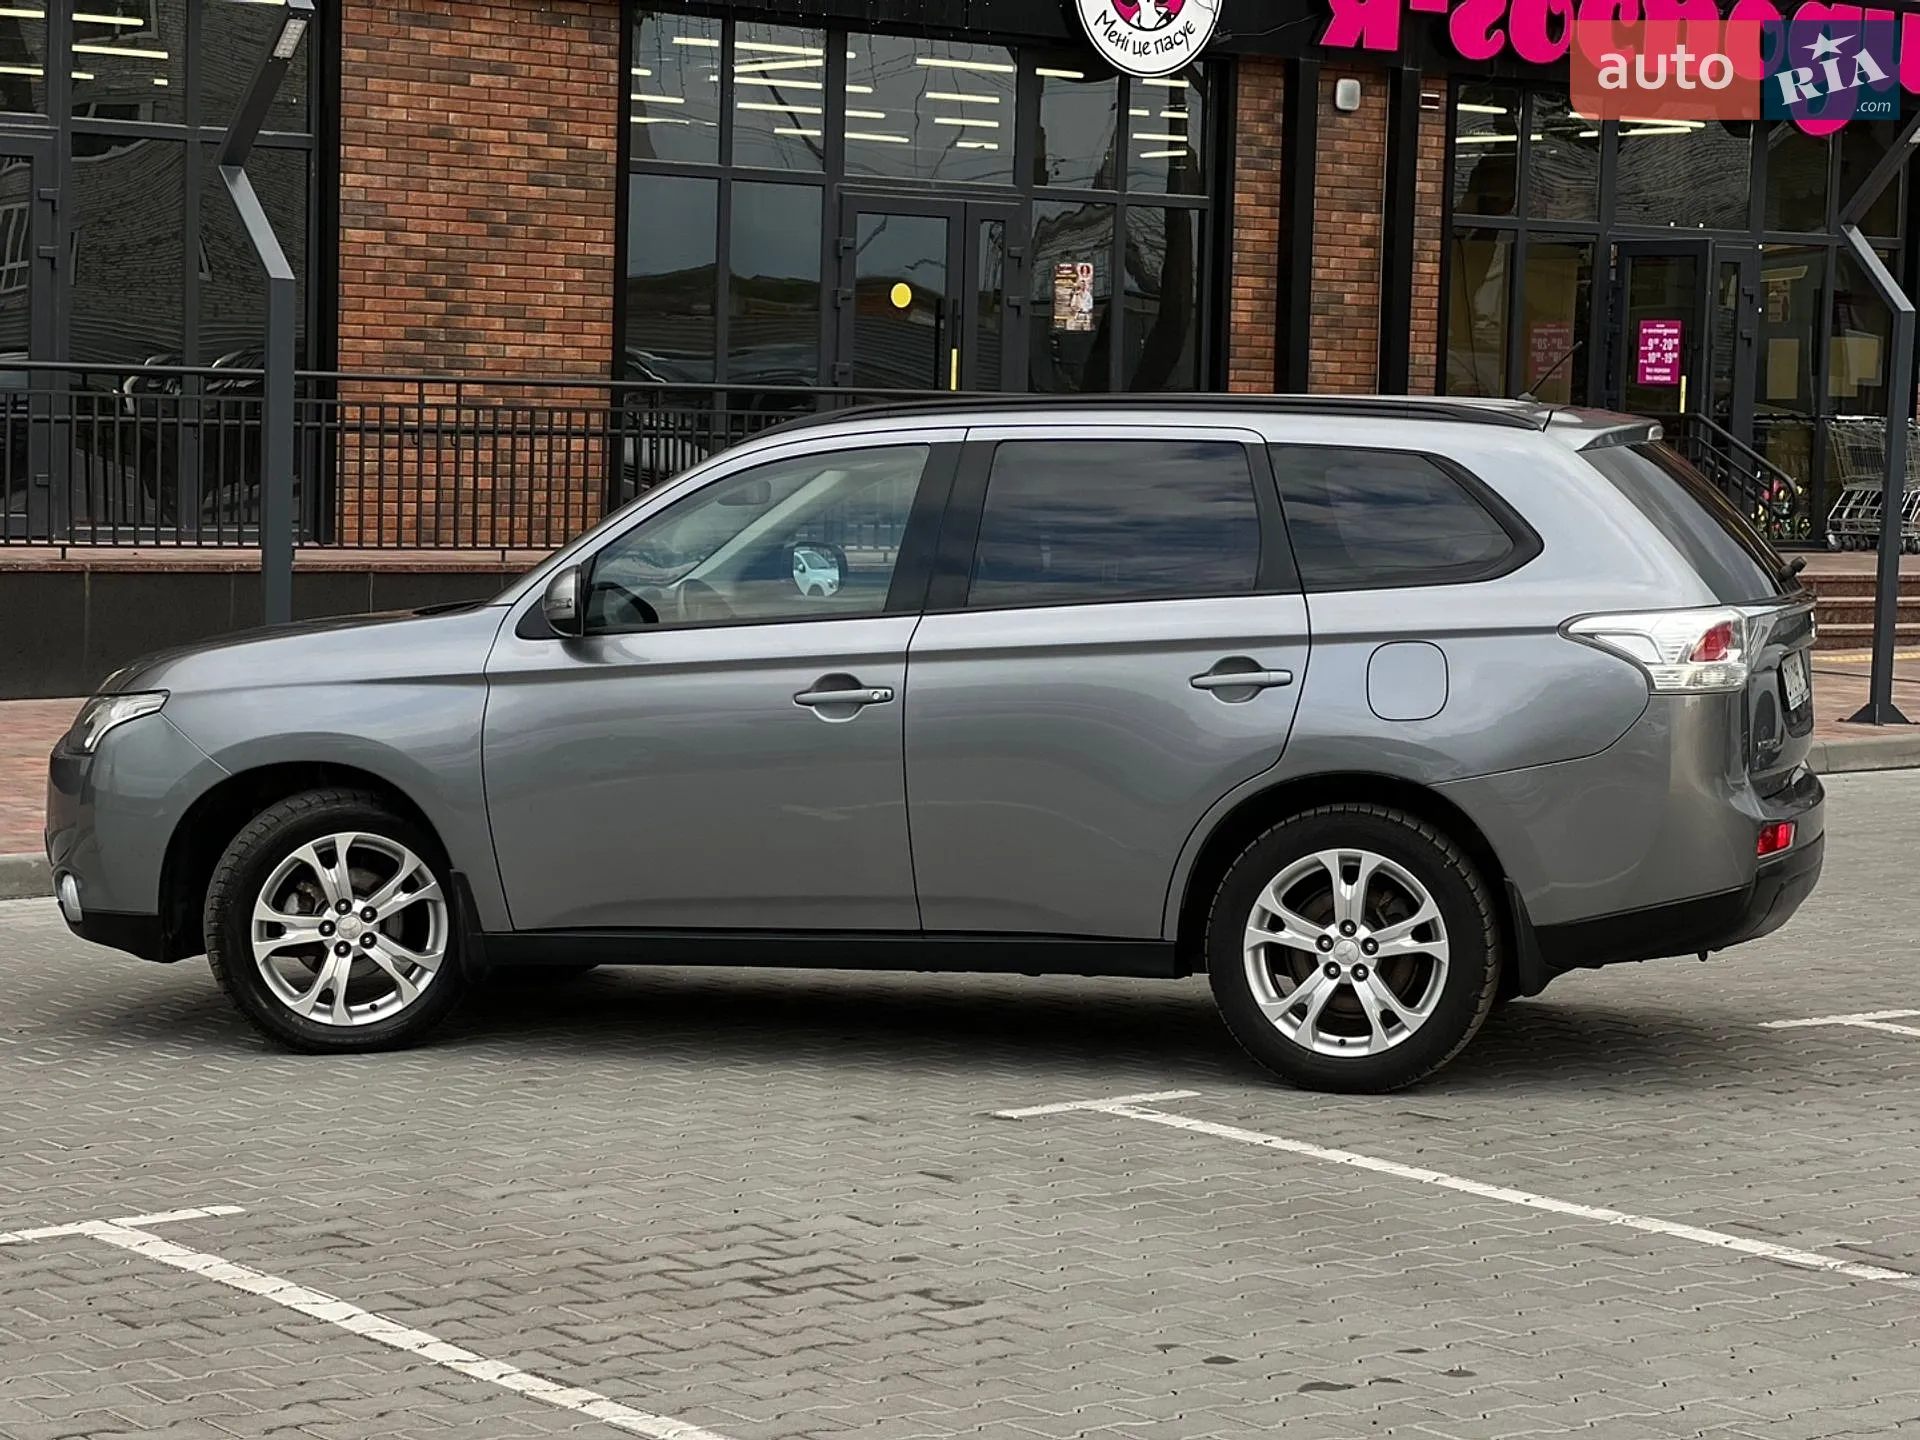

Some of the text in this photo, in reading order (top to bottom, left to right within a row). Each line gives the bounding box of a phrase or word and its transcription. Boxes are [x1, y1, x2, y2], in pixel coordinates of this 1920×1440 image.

[1094, 10, 1196, 57] Мені це пасує
